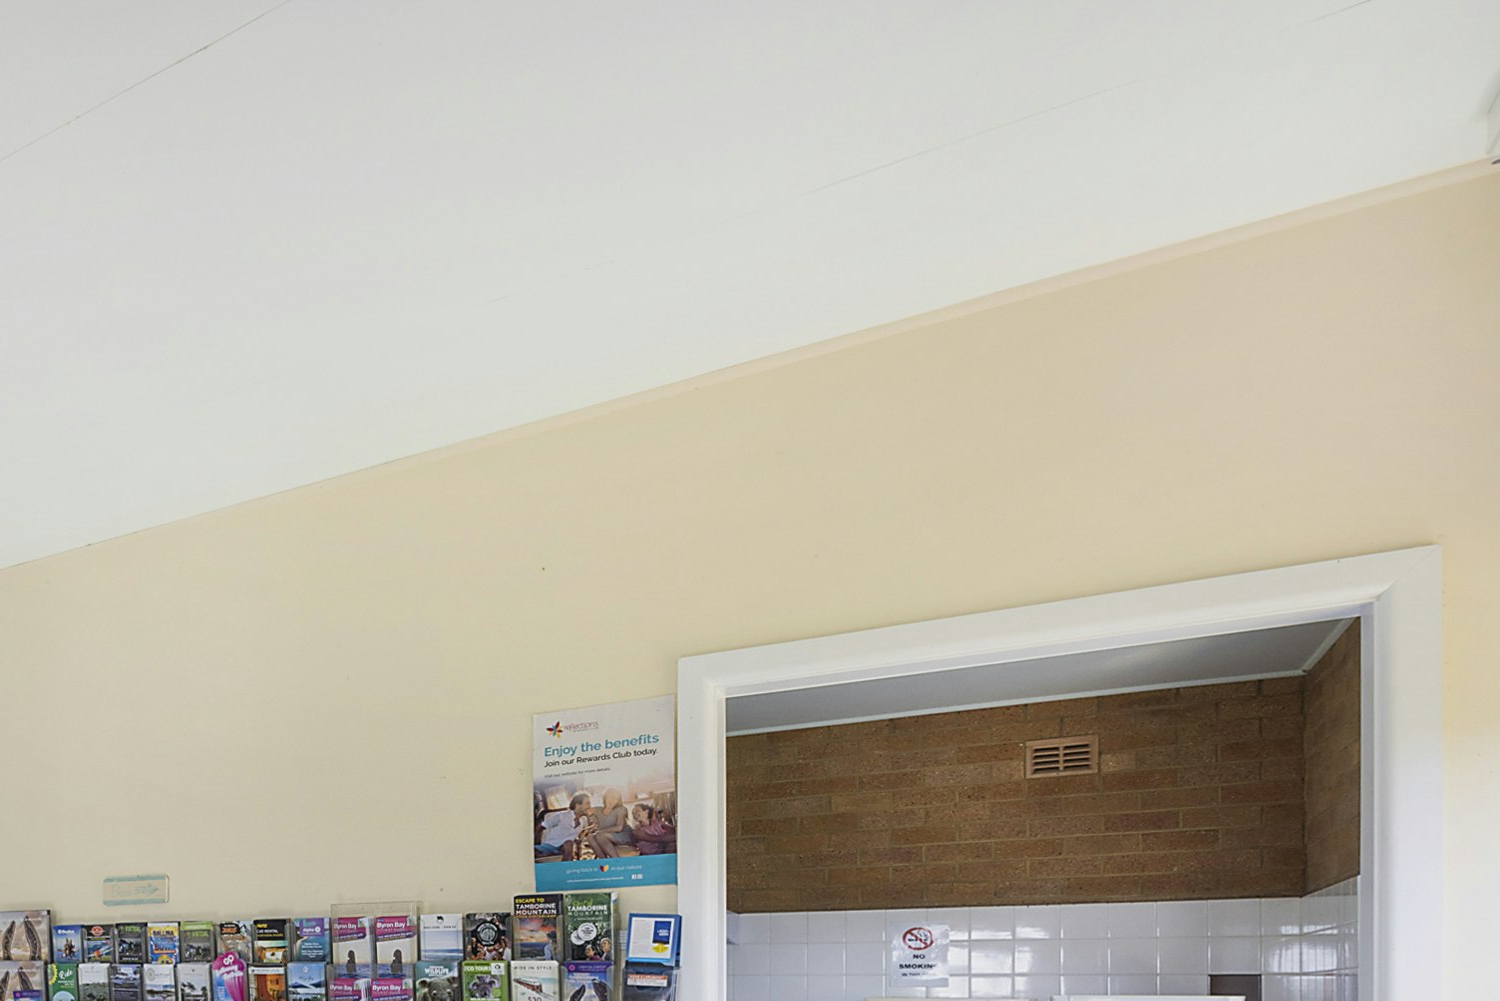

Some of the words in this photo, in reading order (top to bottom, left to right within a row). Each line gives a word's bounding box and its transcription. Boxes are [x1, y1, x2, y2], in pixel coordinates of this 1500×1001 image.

[544, 746, 577, 757] Enjoy
[581, 742, 601, 752] the
[605, 734, 659, 749] benefits
[577, 753, 611, 763] Rewards
[633, 748, 657, 757] today
